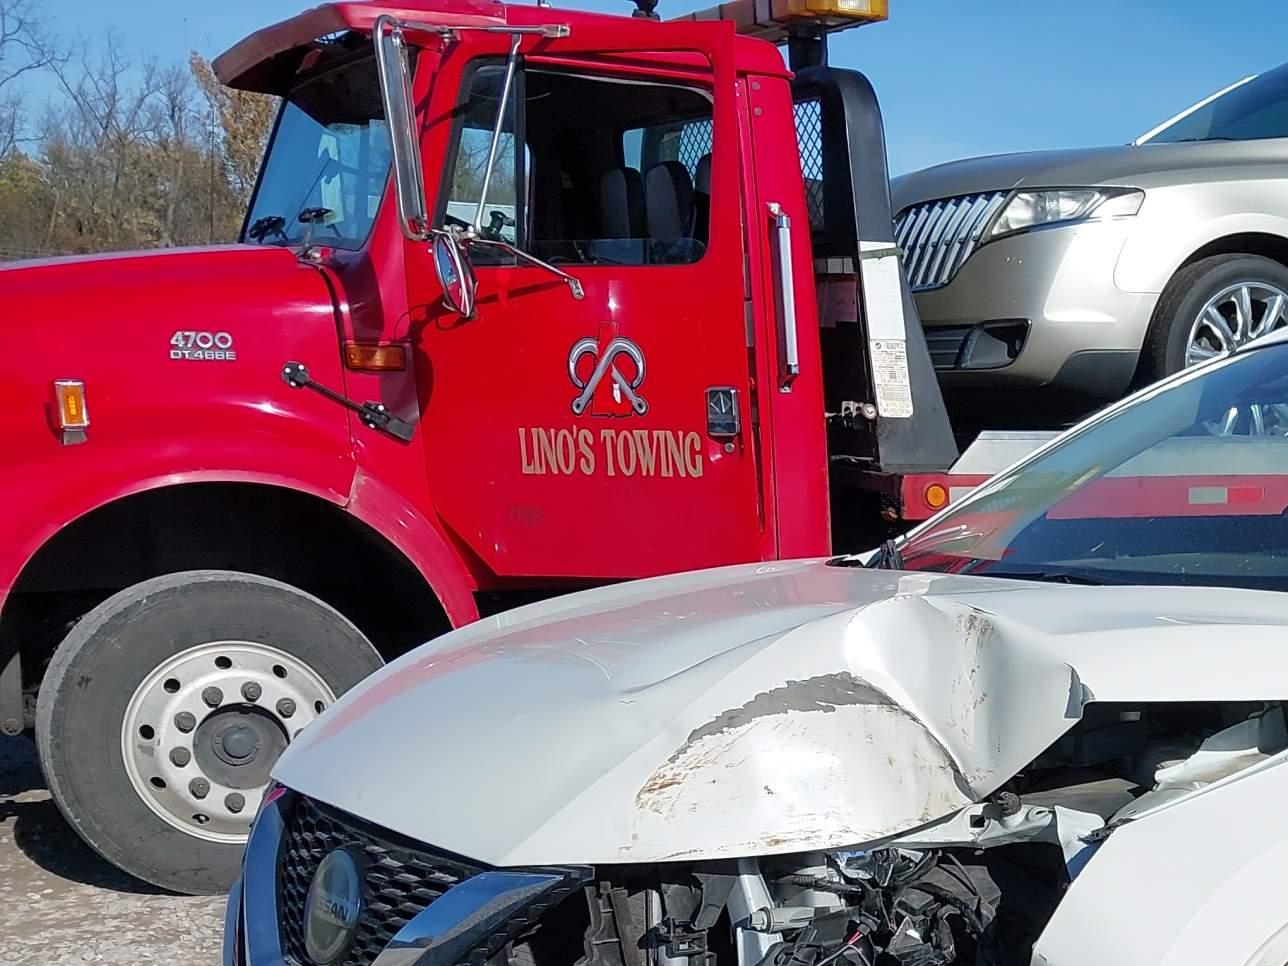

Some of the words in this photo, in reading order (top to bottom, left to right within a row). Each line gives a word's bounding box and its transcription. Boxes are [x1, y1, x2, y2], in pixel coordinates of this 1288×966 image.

[169, 331, 233, 349] 4700
[518, 424, 595, 475] LINO'S
[600, 429, 704, 478] TOWING
